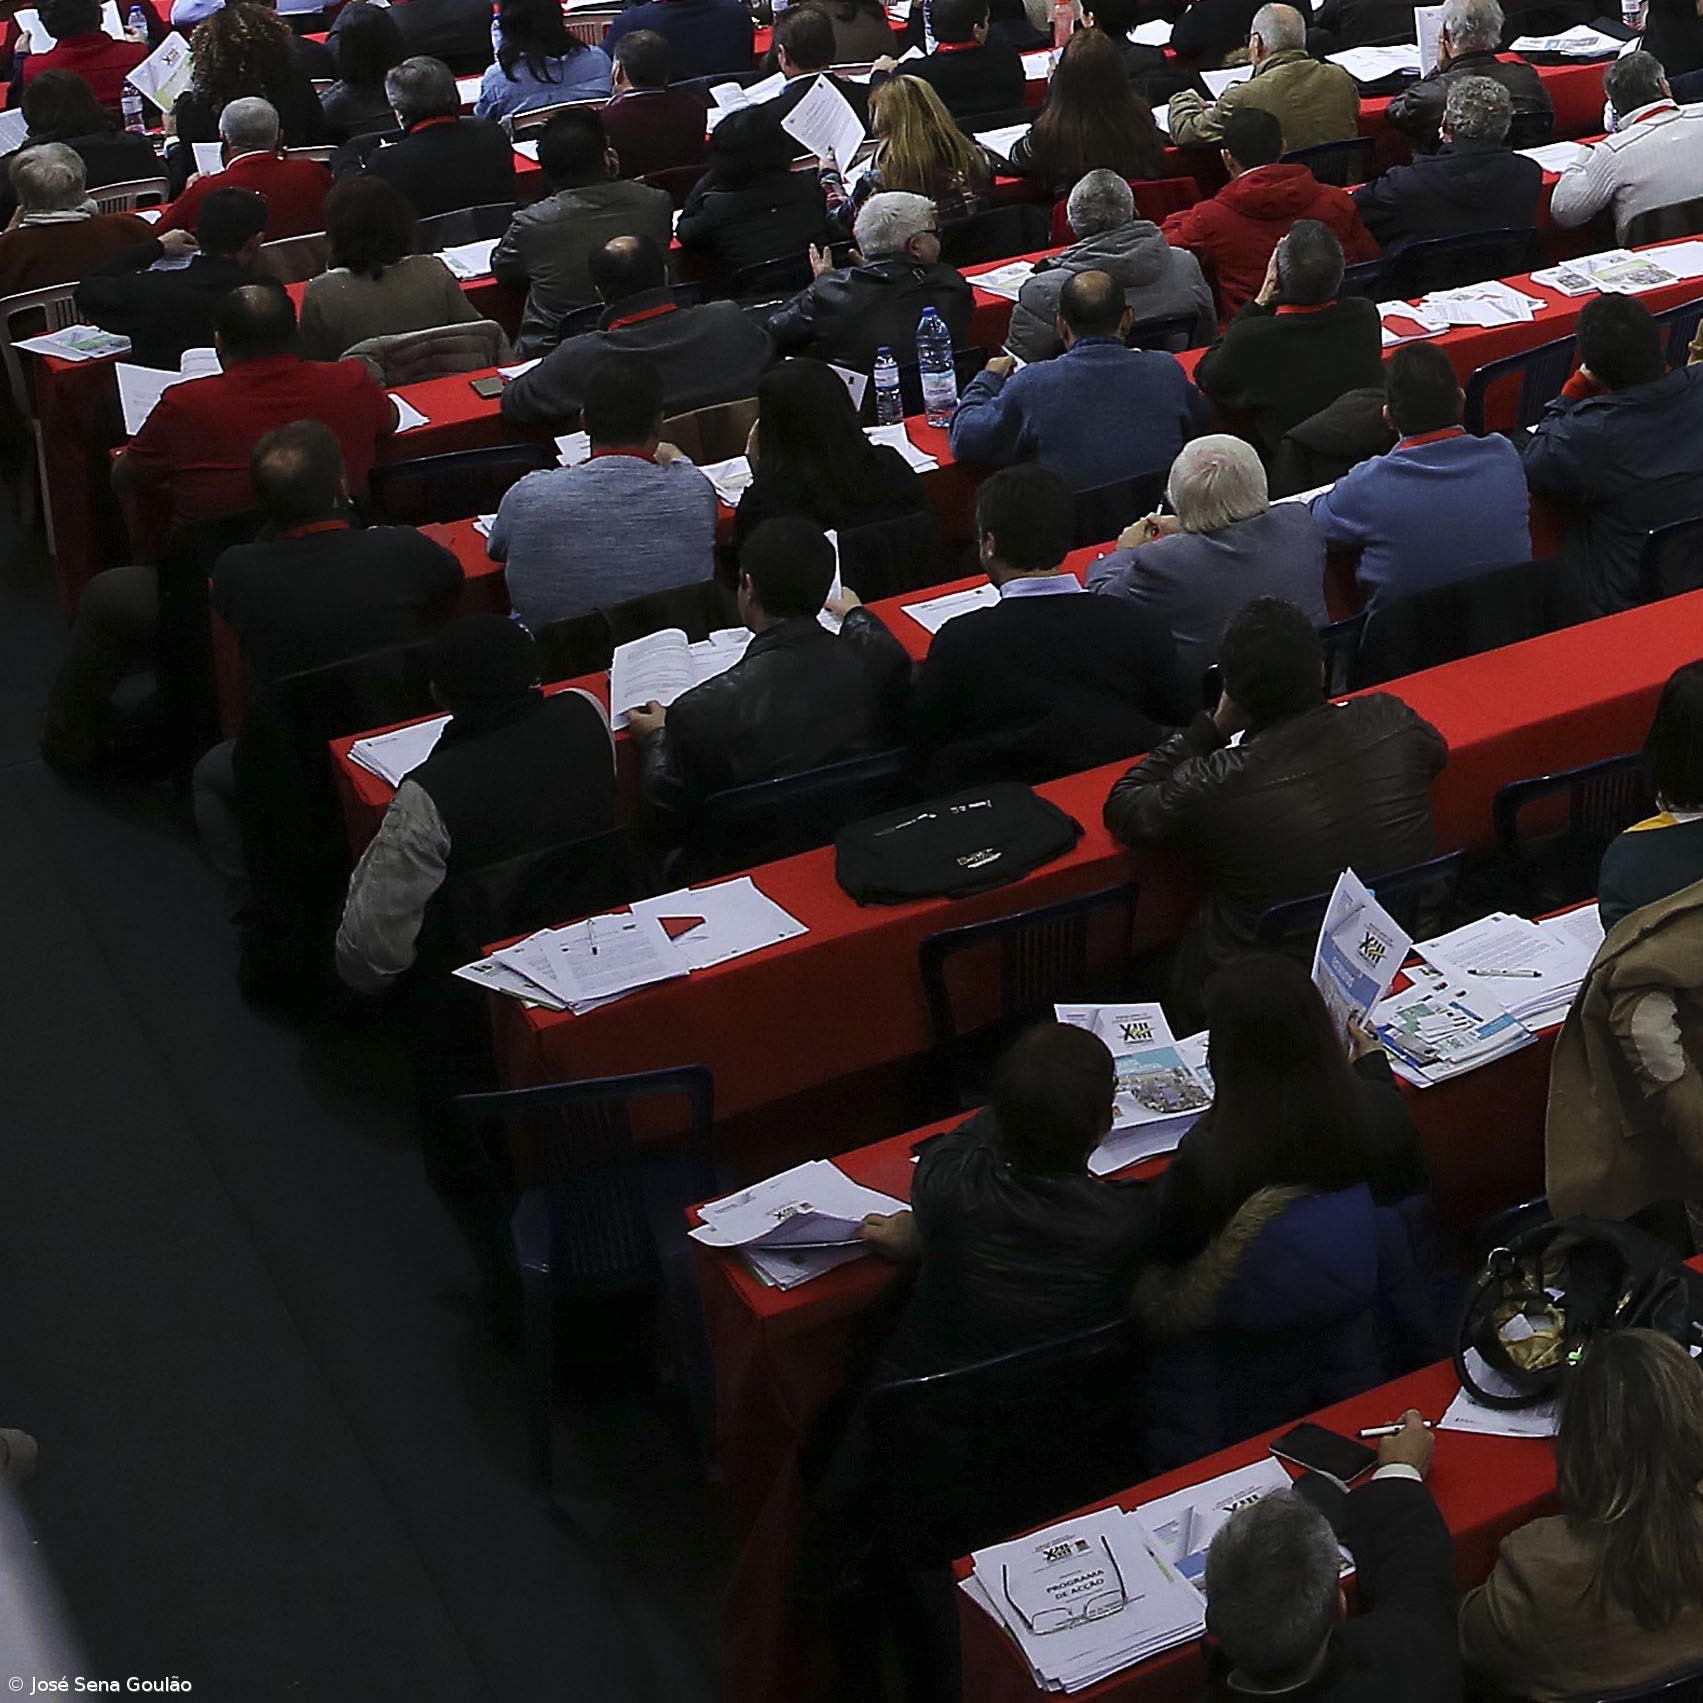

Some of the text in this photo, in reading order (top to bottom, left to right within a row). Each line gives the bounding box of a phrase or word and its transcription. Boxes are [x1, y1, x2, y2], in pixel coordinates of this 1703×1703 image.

[1119, 1022, 1154, 1043] XIII
[1046, 1569, 1106, 1595] PROGRAMA
[1055, 1589, 1069, 1601] DE
